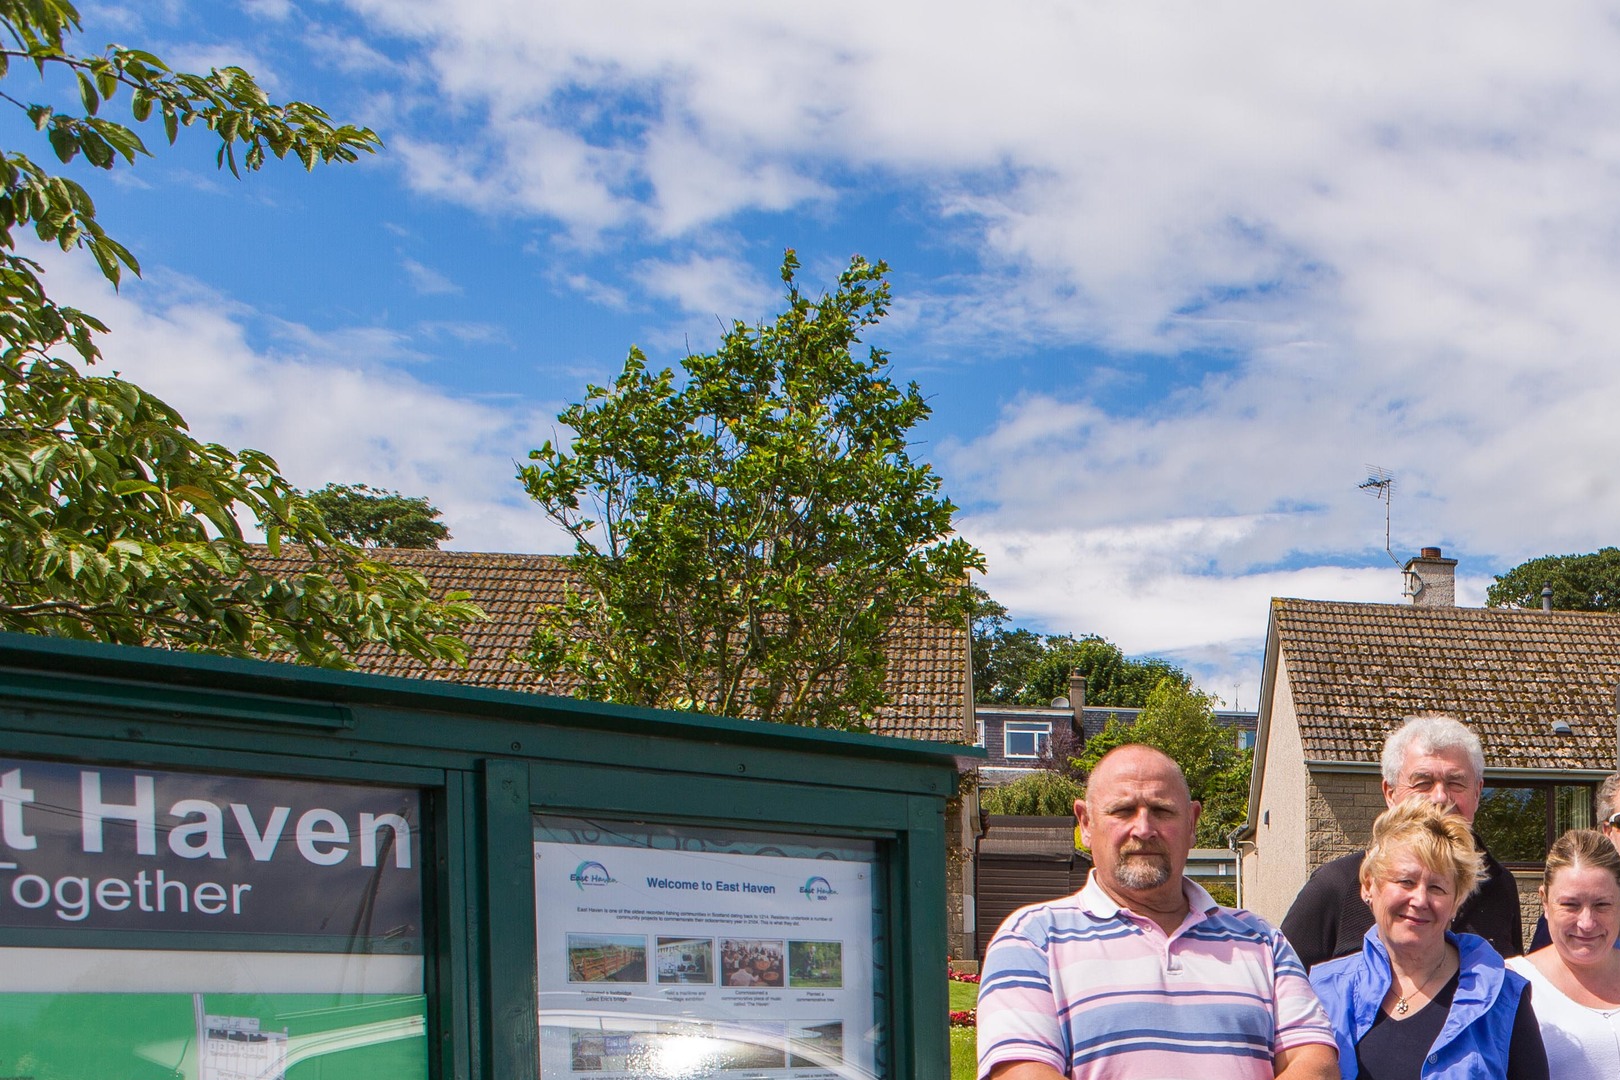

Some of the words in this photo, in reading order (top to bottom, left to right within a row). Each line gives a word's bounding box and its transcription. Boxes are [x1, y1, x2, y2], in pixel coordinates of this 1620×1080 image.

[81, 771, 412, 869] Haven
[0, 862, 251, 921] ogether
[647, 877, 699, 891] Welcome
[701, 880, 712, 891] to
[716, 881, 740, 893] East
[743, 882, 775, 894] Haven
